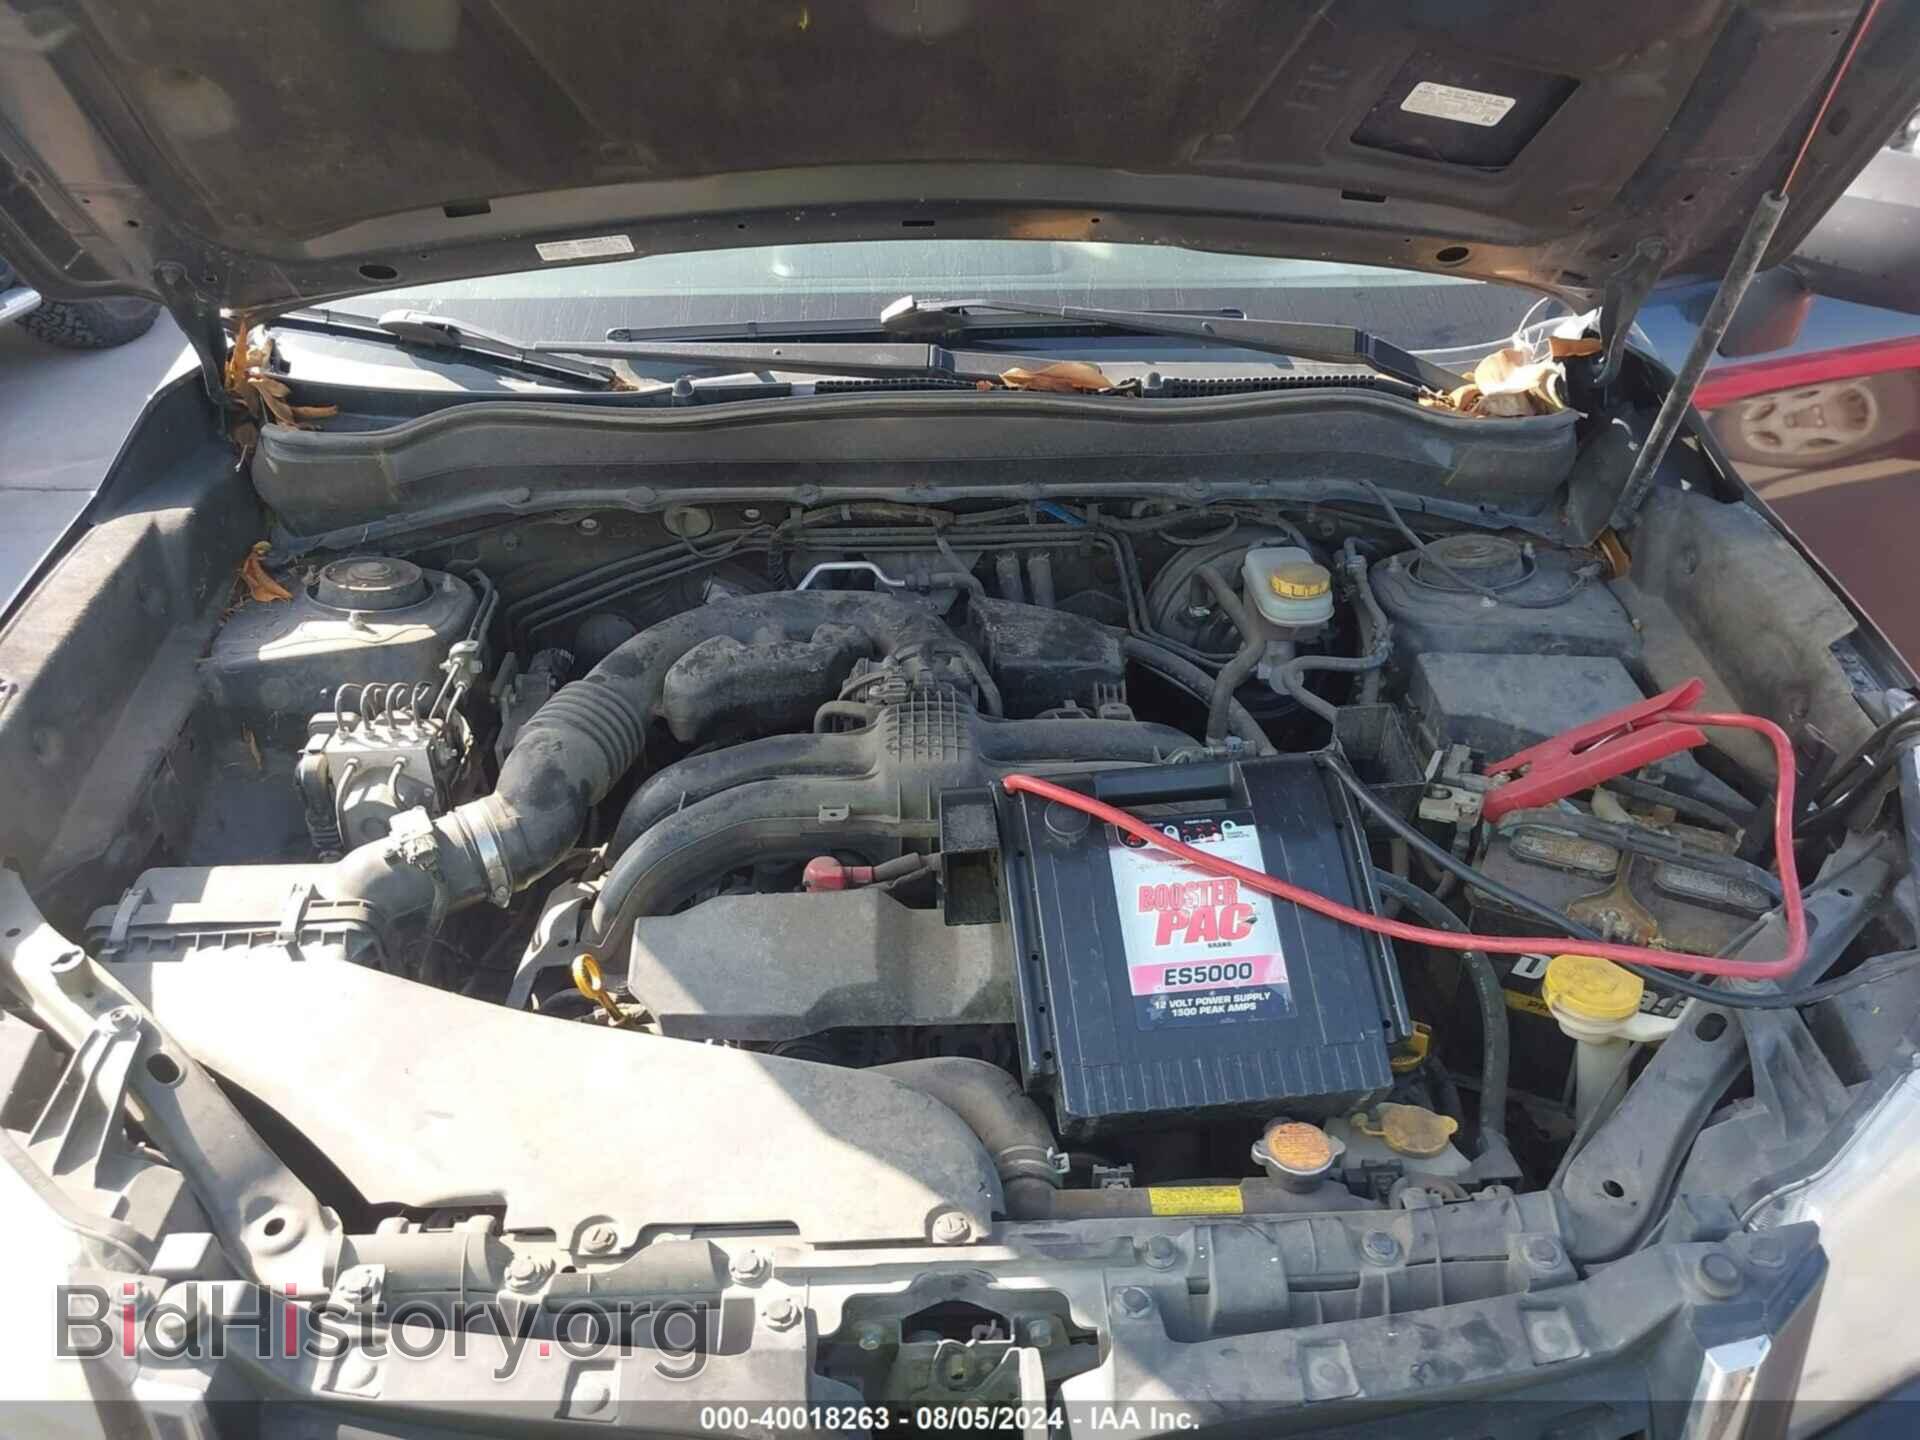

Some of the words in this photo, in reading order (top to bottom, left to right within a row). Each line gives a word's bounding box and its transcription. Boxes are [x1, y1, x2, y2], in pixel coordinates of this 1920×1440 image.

[1138, 878, 1239, 912] BOOSTER
[1155, 902, 1254, 946] PAC
[1164, 962, 1253, 986] ES5000
[1154, 1000, 1167, 1009] 12
[1168, 998, 1194, 1009] VOLT
[1195, 994, 1232, 1006] POWER
[1233, 991, 1271, 1003] SUPPLY
[1171, 1007, 1197, 1017] 1500
[1199, 1004, 1225, 1015] PEAK
[1227, 1001, 1257, 1013] AMPS
